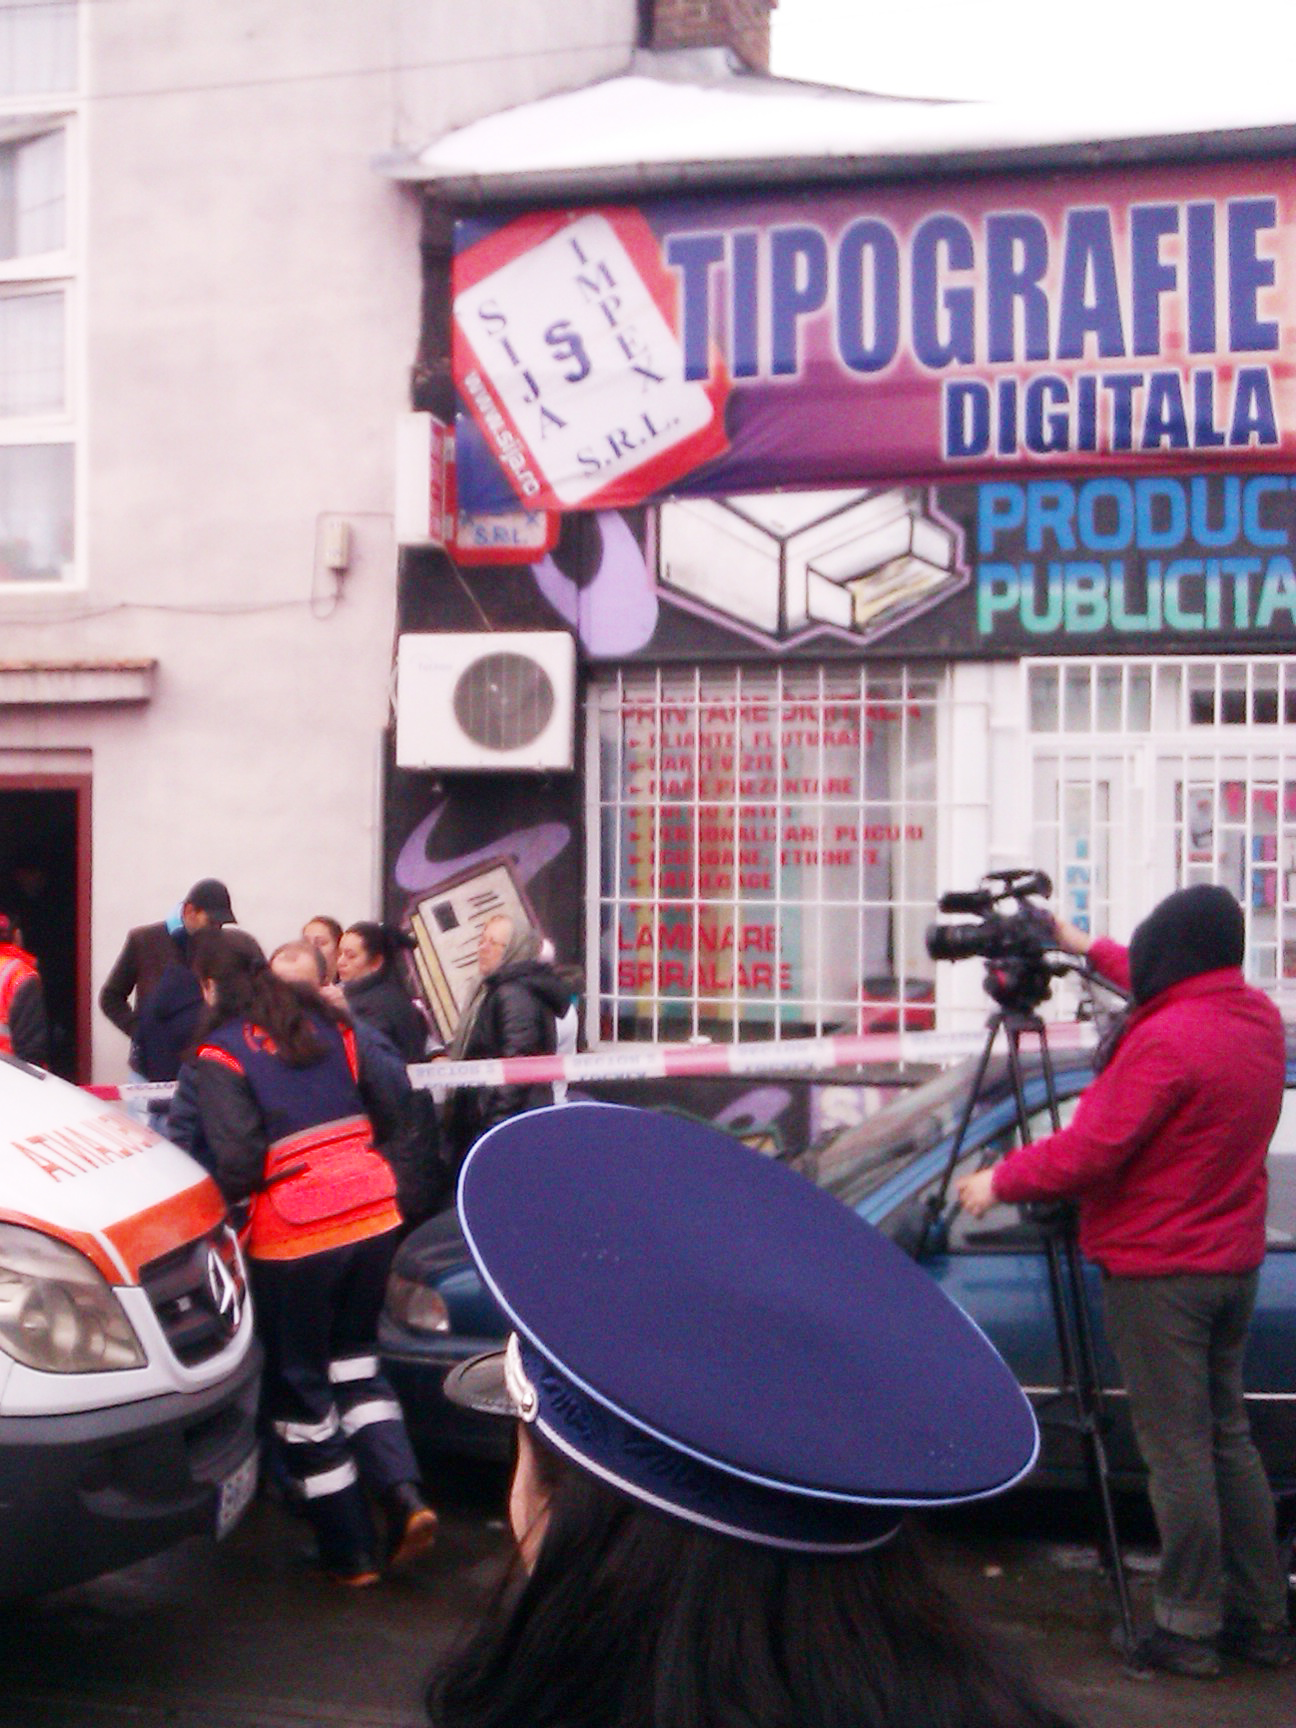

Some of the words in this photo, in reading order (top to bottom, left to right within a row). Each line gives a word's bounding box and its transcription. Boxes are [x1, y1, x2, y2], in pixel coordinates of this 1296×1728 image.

[570, 238, 665, 393] IMPEX
[666, 198, 1281, 381] TIPOGRAFIE
[478, 300, 567, 440] SIJA
[945, 365, 1281, 458] DIGITALA
[577, 412, 680, 477] S.R.L.
[978, 474, 1296, 555] PRODUC
[617, 959, 793, 990] SPIRALARE
[618, 922, 783, 953] LAMINARE
